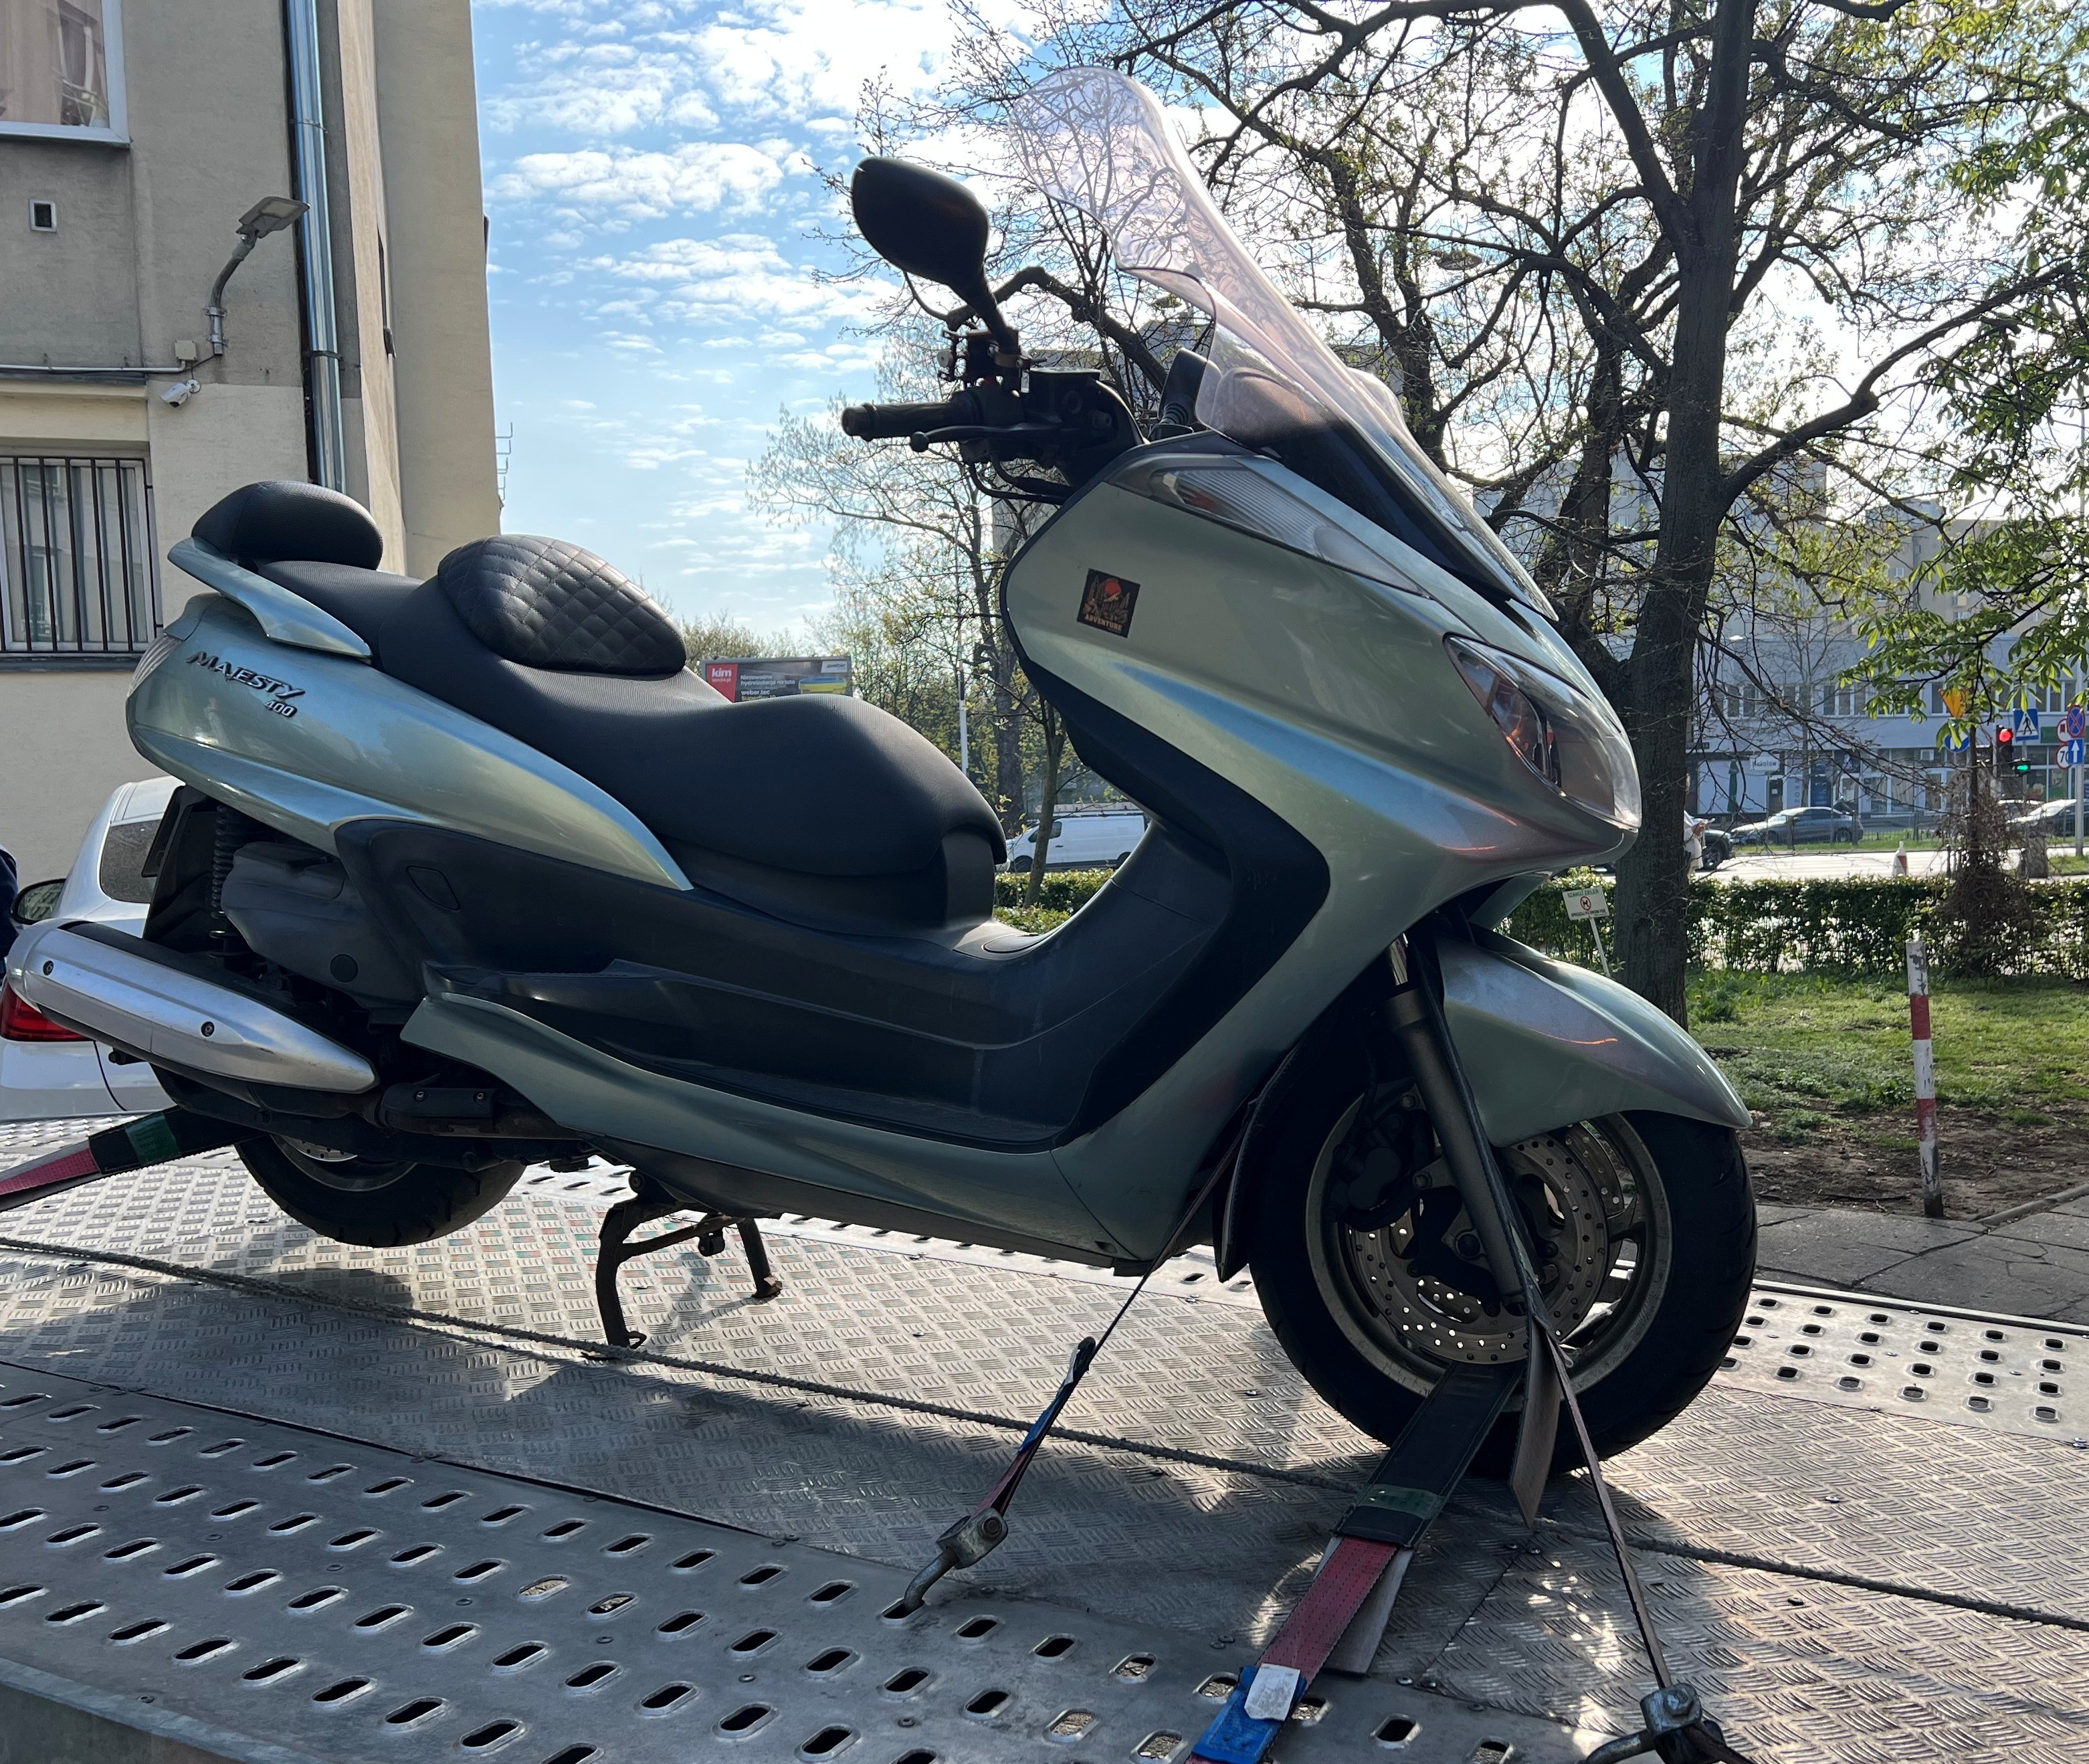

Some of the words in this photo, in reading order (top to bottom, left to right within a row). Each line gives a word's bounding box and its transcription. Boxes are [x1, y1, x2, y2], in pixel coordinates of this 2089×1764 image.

[1084, 613, 1123, 631] ADVENTURE
[184, 651, 305, 699] MAJESTY
[711, 668, 732, 678] kim
[264, 700, 298, 718] 400
